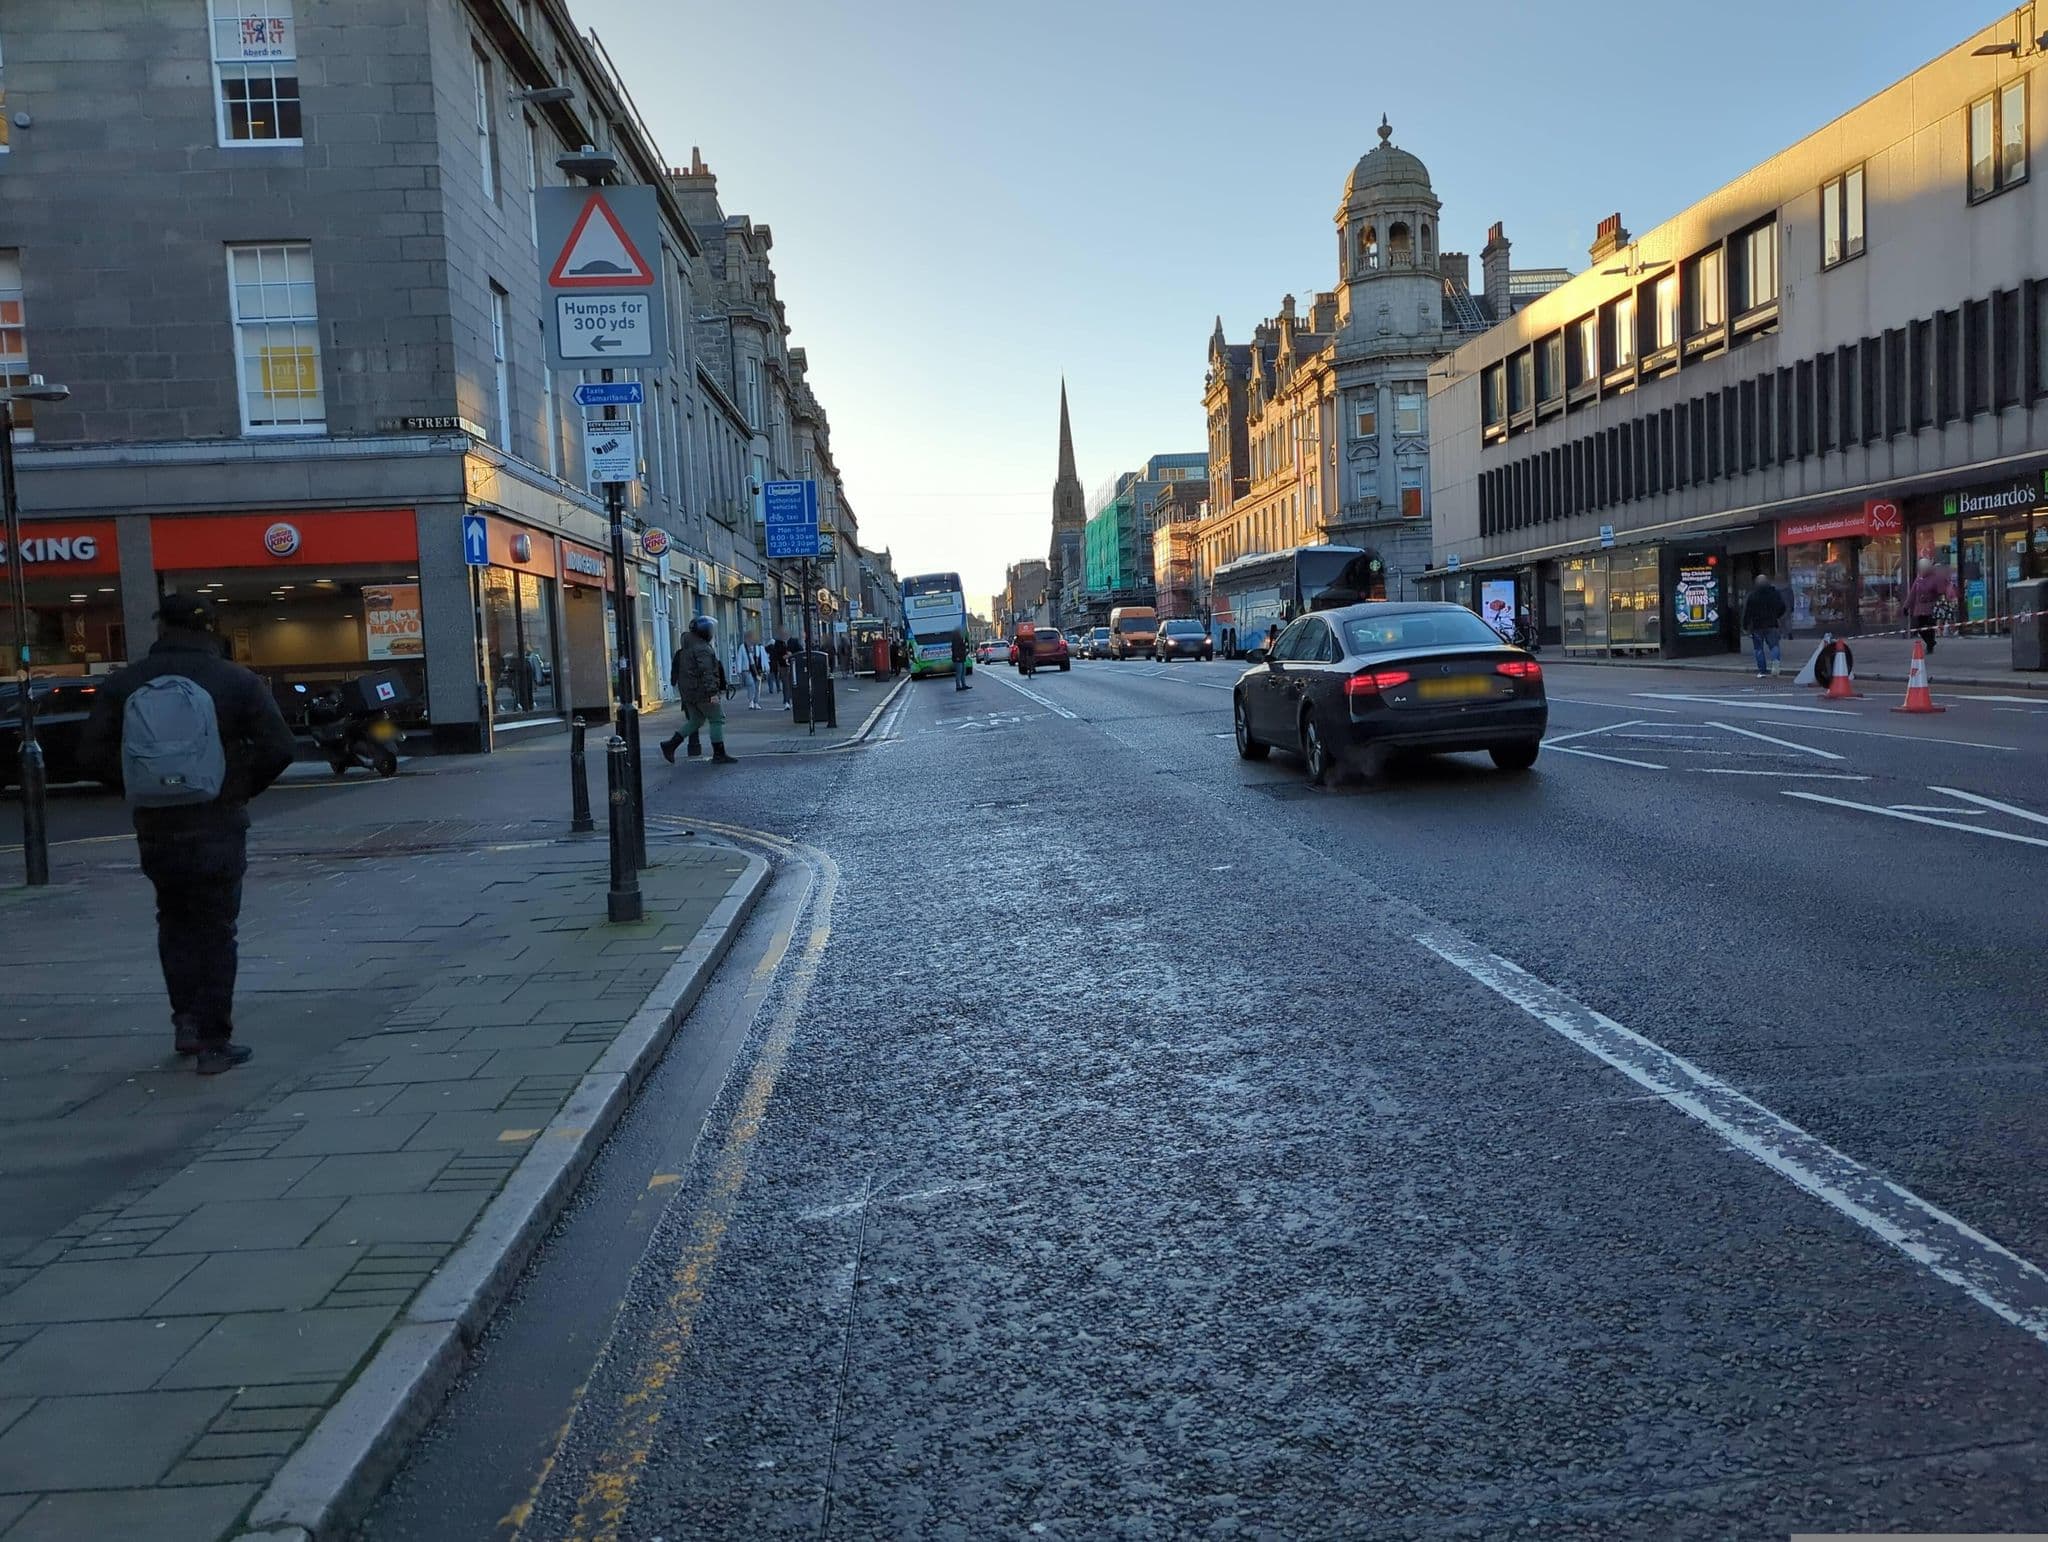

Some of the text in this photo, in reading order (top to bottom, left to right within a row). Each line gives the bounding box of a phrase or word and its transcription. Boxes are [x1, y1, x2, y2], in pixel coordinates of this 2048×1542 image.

[243, 48, 282, 57] Aberden
[565, 301, 642, 316] Humps for
[574, 317, 635, 331] 300 yds
[586, 394, 628, 402] Samaritans
[407, 416, 460, 428] STREET
[1960, 483, 2036, 513] Barnardo's
[1802, 525, 1816, 533] Heart
[1816, 519, 1844, 530] Foundation
[270, 535, 293, 548] KING
[644, 532, 665, 543] BURGER
[645, 538, 667, 550] KING
[20, 536, 96, 562] KING
[369, 609, 417, 624] SPICY
[370, 621, 419, 634] MAYO
[380, 687, 390, 696] L
